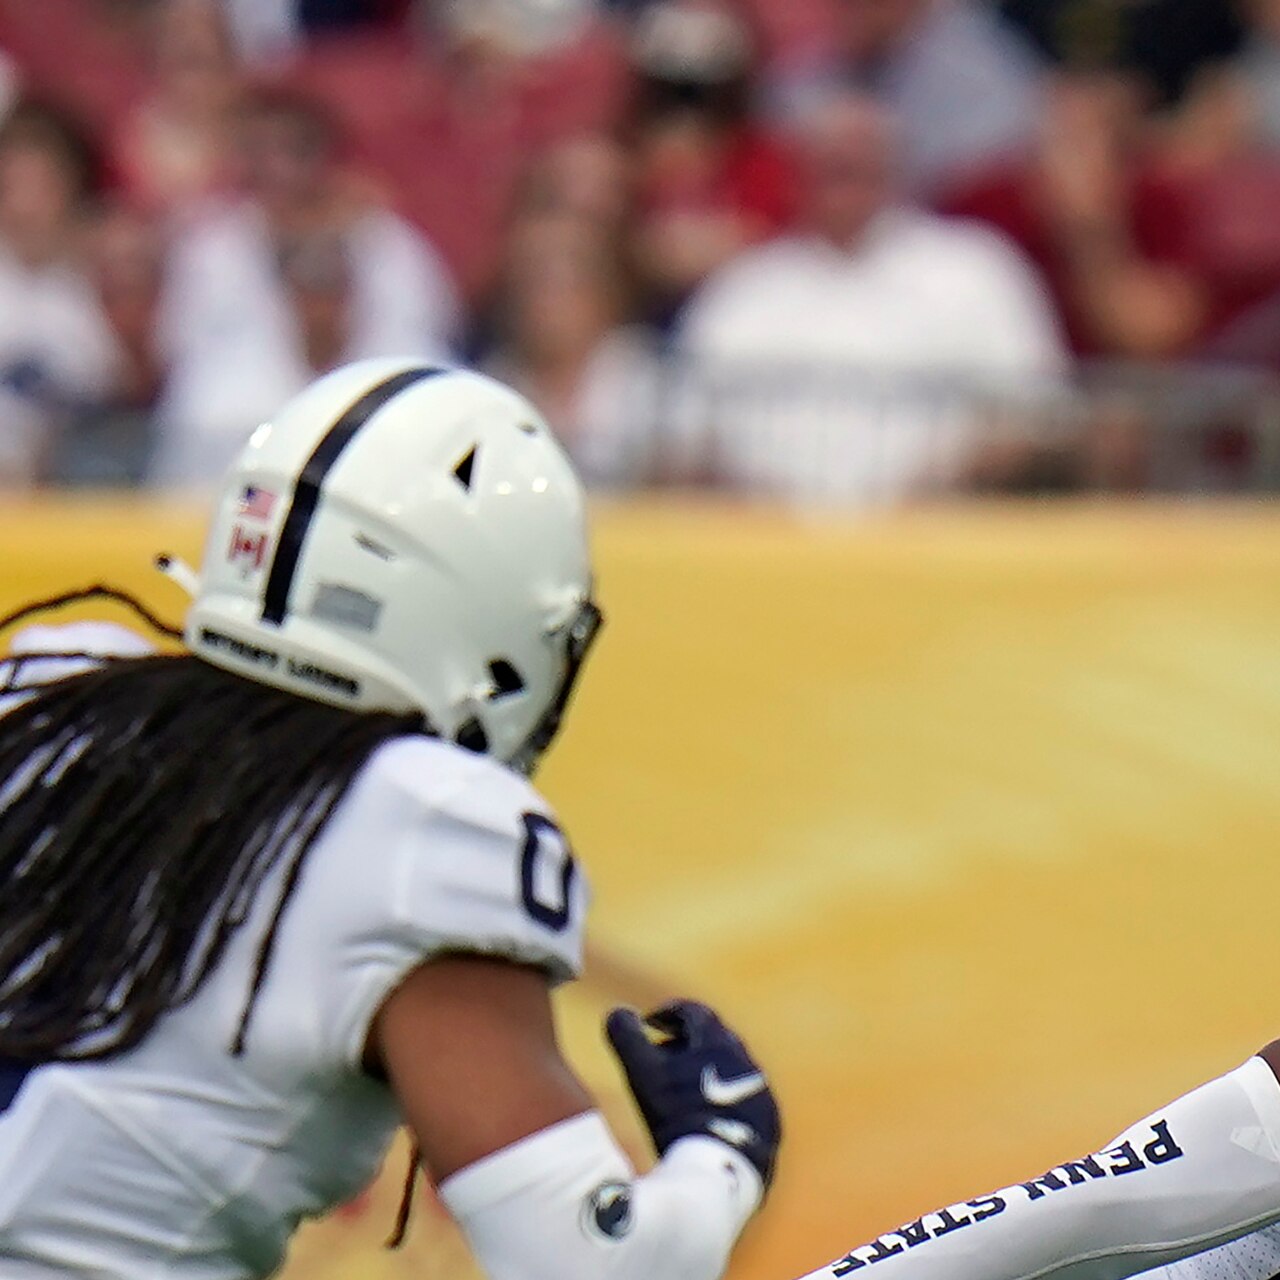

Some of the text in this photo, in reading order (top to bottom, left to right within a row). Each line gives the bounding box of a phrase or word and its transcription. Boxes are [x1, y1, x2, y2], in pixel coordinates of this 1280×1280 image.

[520, 811, 576, 933] 0
[831, 1118, 1184, 1279] PENN STATE
